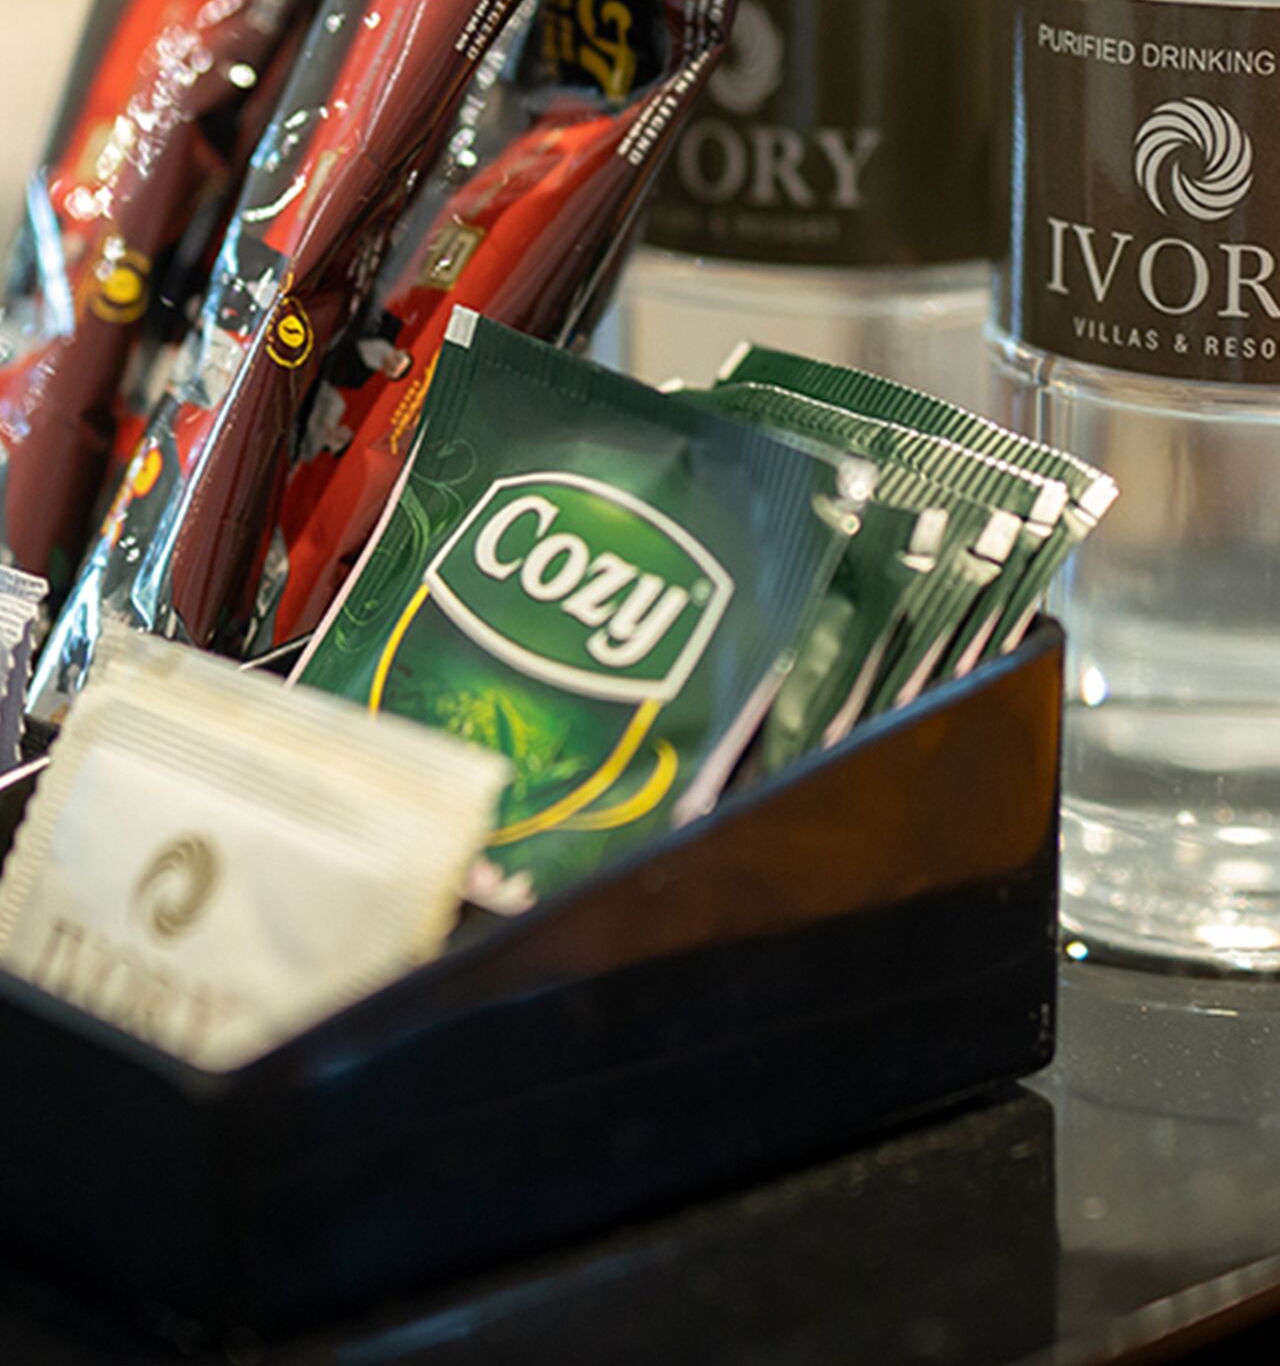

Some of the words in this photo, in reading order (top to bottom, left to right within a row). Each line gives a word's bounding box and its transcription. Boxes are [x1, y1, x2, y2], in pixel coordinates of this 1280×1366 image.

[1037, 22, 1136, 66] PURIFIED
[1141, 42, 1277, 77] DRINKING
[676, 120, 883, 208] ORY
[1072, 316, 1161, 352] VILLAS
[1174, 333, 1190, 354] &
[474, 495, 690, 668] Cozy
